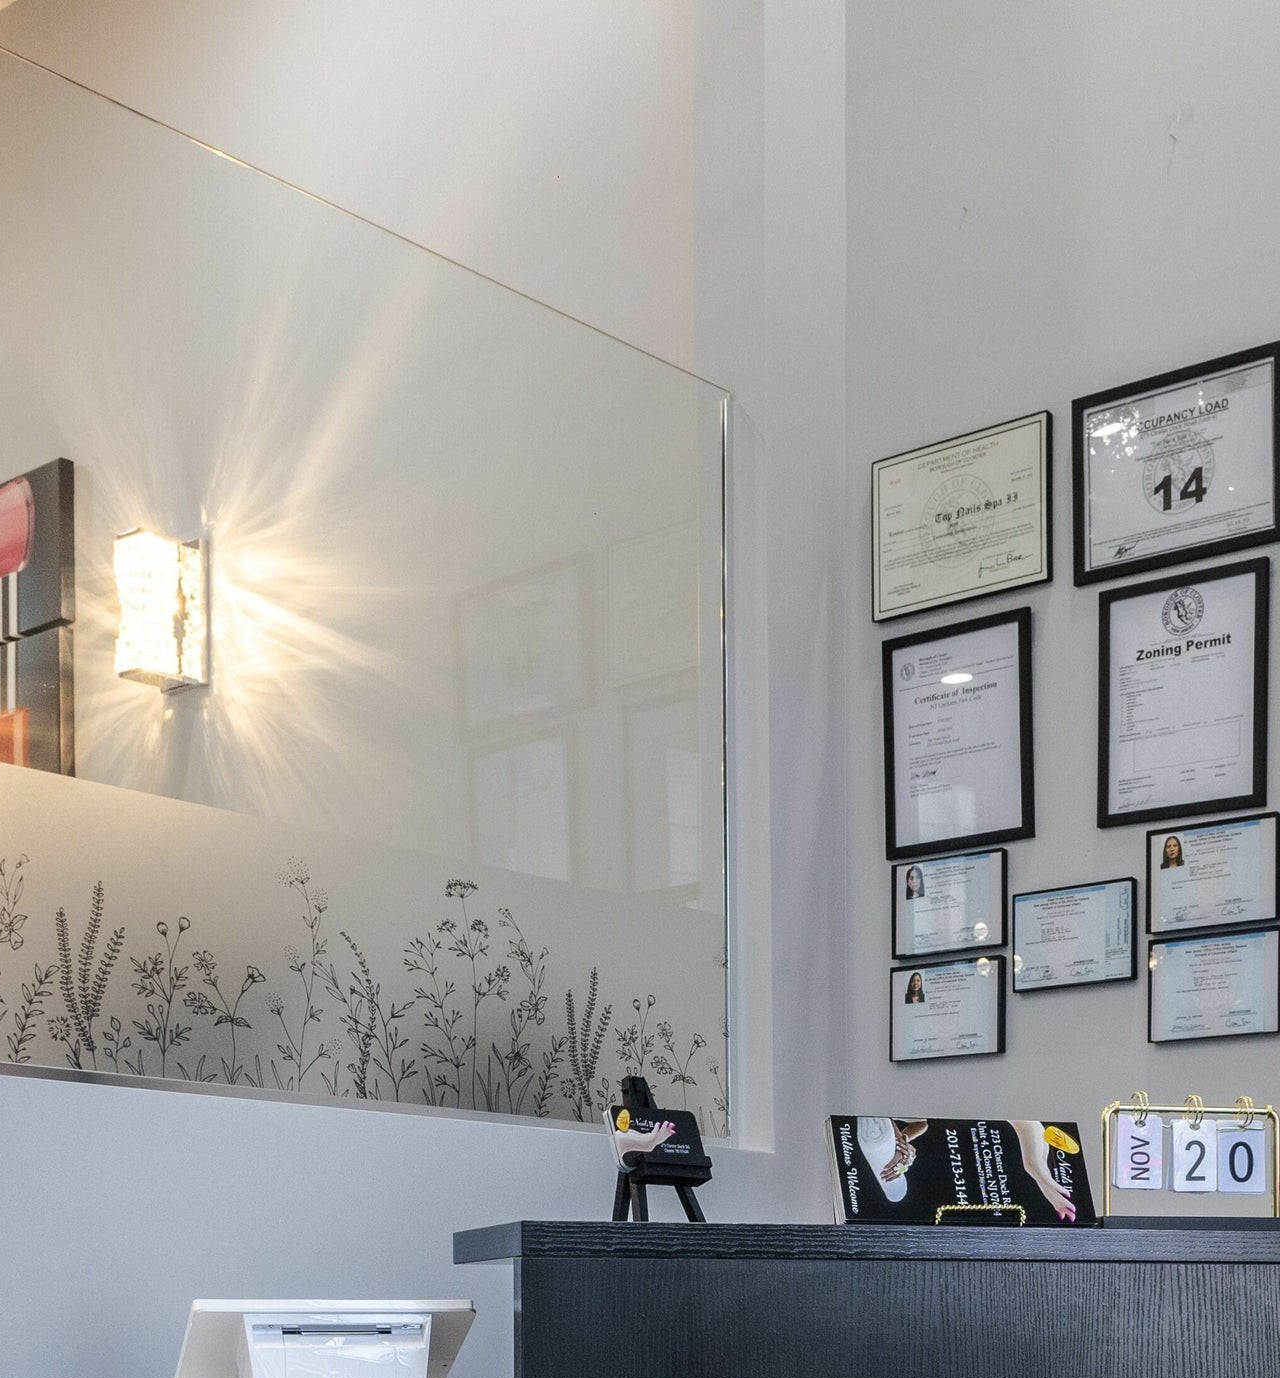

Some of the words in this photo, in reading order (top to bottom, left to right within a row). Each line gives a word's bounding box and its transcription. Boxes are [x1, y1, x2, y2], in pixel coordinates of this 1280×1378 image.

[1136, 406, 1196, 432] CCUPANCY
[1199, 398, 1229, 415] LOAD
[1154, 466, 1207, 511] 14
[935, 513, 953, 524] Top
[956, 504, 981, 520] Nails
[984, 499, 1003, 511] Spa
[1136, 645, 1182, 661] Zoning
[1186, 633, 1231, 651] Permit
[914, 688, 950, 705] Certificate
[952, 688, 959, 697] of
[962, 681, 998, 695] Inspection
[990, 1129, 1001, 1144] 273
[840, 1123, 854, 1167] Walkins
[847, 1167, 860, 1215] Welcome
[946, 1129, 969, 1206] 201-713-3144
[977, 1121, 988, 1139] Unit
[987, 1180, 998, 1191] NJ
[994, 1144, 1004, 1173] Closter
[1056, 1150, 1073, 1184] Nails
[1130, 1135, 1150, 1181] NOV
[998, 1174, 1010, 1196] Dock
